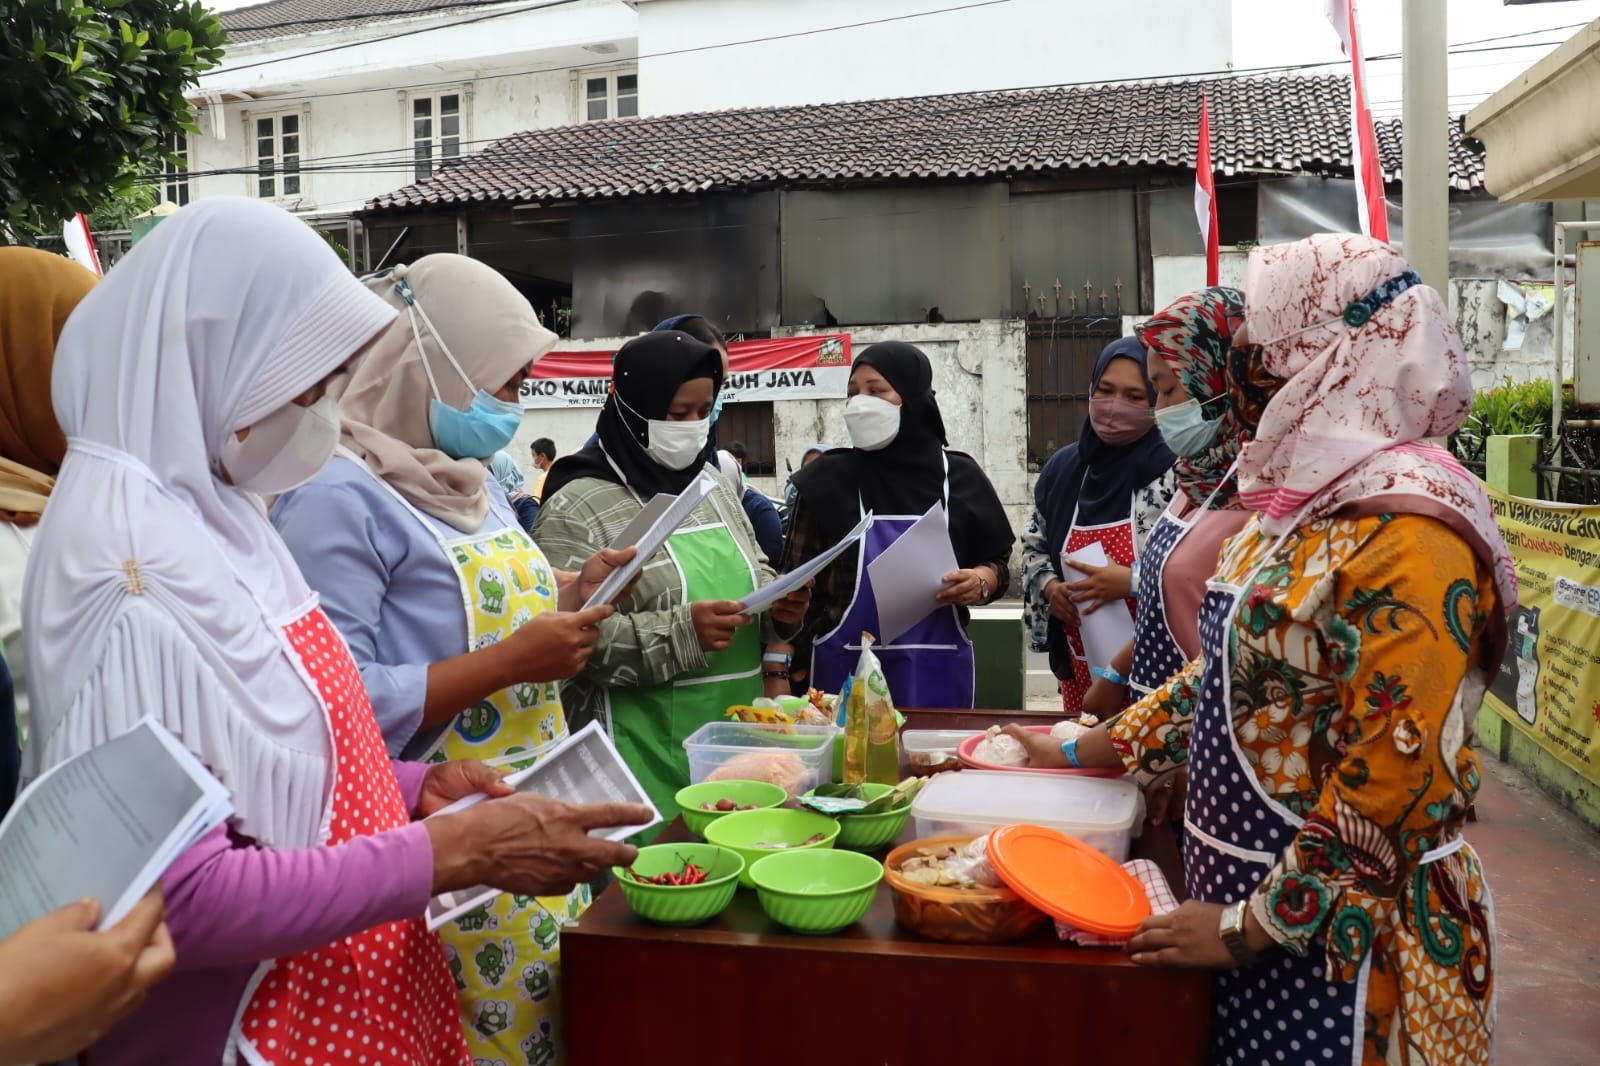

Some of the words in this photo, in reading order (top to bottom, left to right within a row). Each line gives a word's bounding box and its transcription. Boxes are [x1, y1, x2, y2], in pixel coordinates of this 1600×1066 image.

[519, 380, 557, 396] SKO
[765, 370, 816, 388] JAYA
[1509, 501, 1572, 534] Vaksinasi
[1520, 532, 1564, 557] Covid-19
